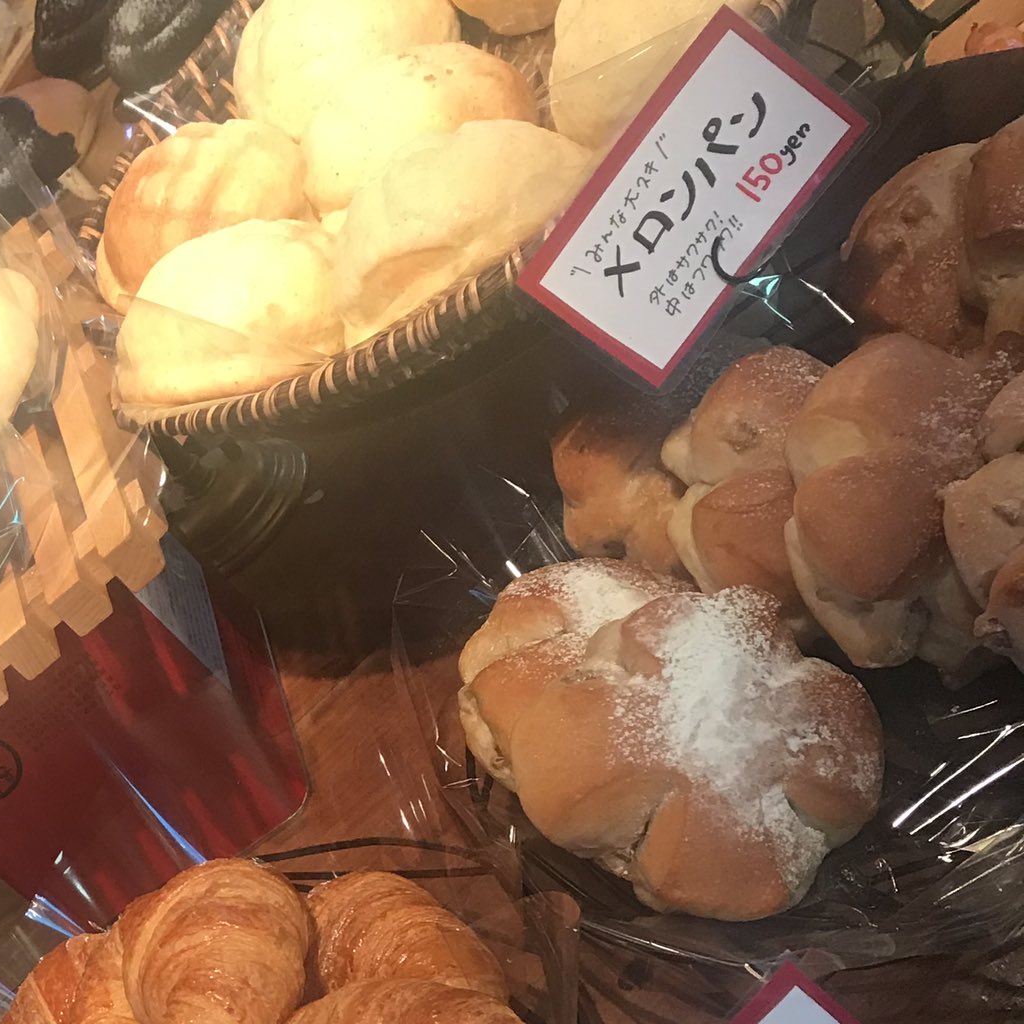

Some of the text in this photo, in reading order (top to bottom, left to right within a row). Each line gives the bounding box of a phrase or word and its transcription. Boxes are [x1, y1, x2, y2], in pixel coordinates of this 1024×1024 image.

[603, 91, 767, 298] メロンパン
